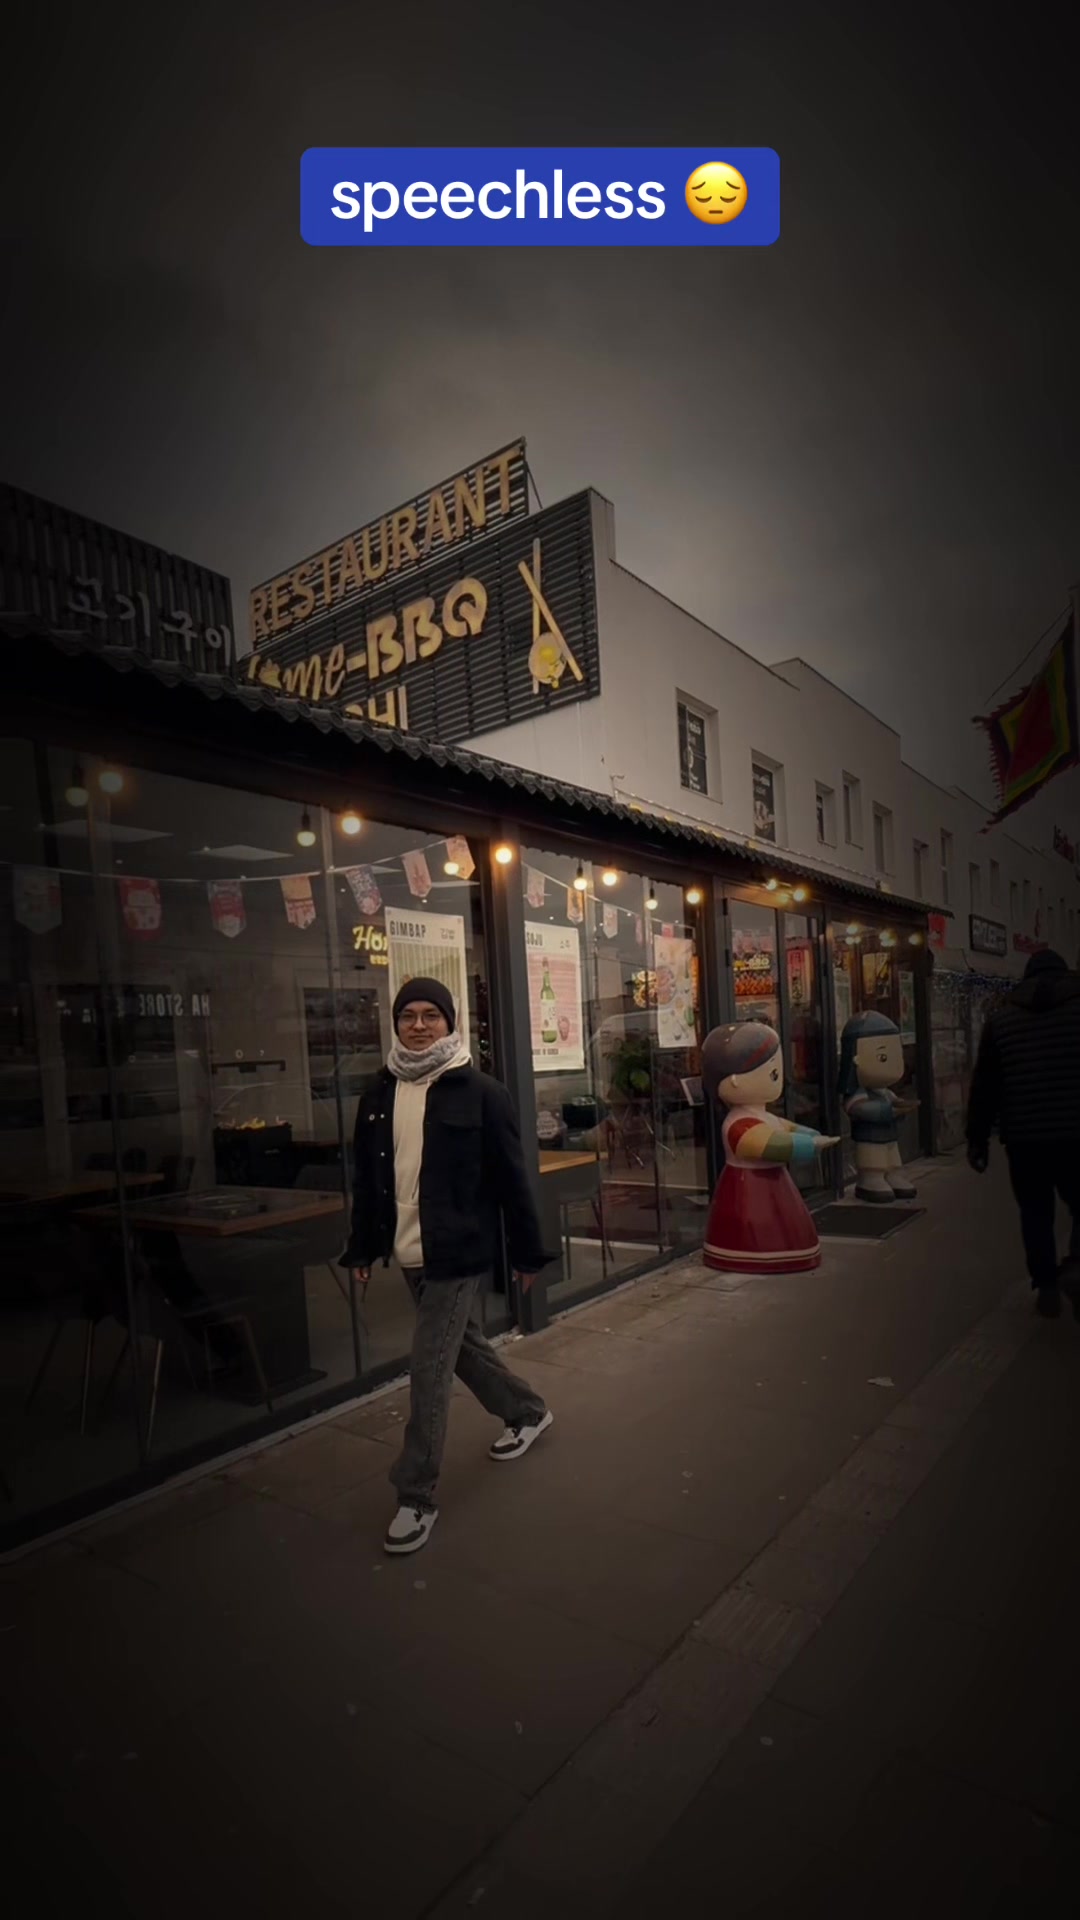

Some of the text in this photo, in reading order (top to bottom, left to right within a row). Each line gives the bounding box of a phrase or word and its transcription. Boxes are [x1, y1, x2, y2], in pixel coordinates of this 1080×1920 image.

[249, 448, 522, 639] RESTAURANT
[389, 920, 426, 938] GIMBAP
[526, 931, 543, 946] SOJU
